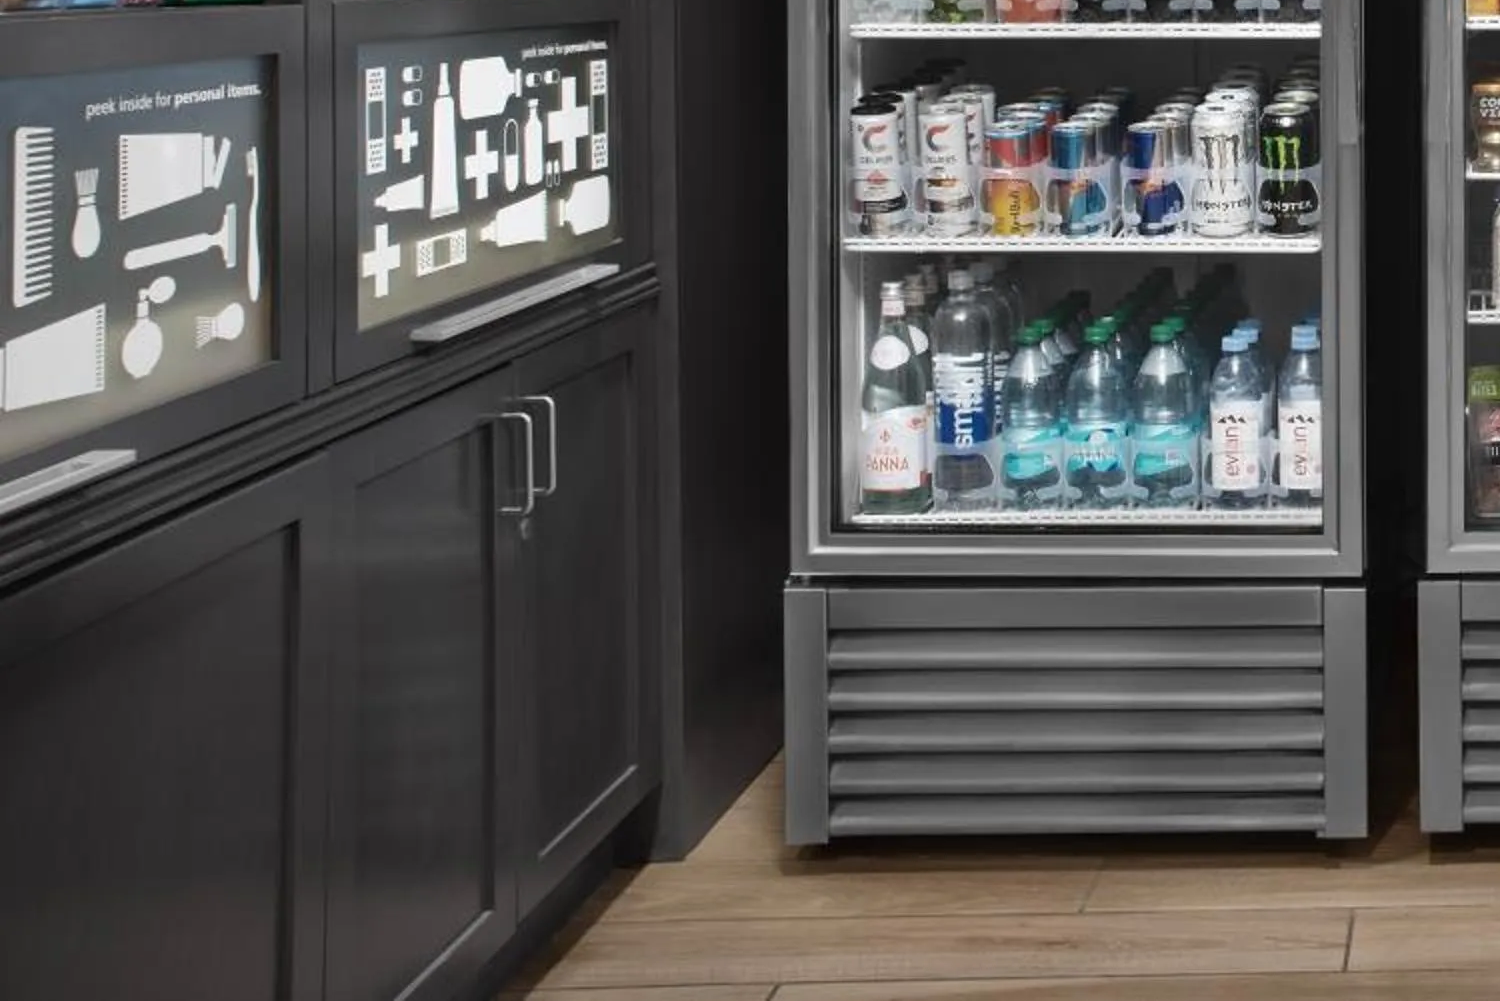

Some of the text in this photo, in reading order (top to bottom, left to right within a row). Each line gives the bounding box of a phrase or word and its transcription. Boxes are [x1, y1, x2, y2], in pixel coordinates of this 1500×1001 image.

[86, 98, 116, 121] peek
[119, 94, 153, 112] inside
[155, 90, 172, 107] for
[173, 84, 226, 109] personal
[1224, 426, 1240, 477] evian
[1292, 426, 1308, 477] evian
